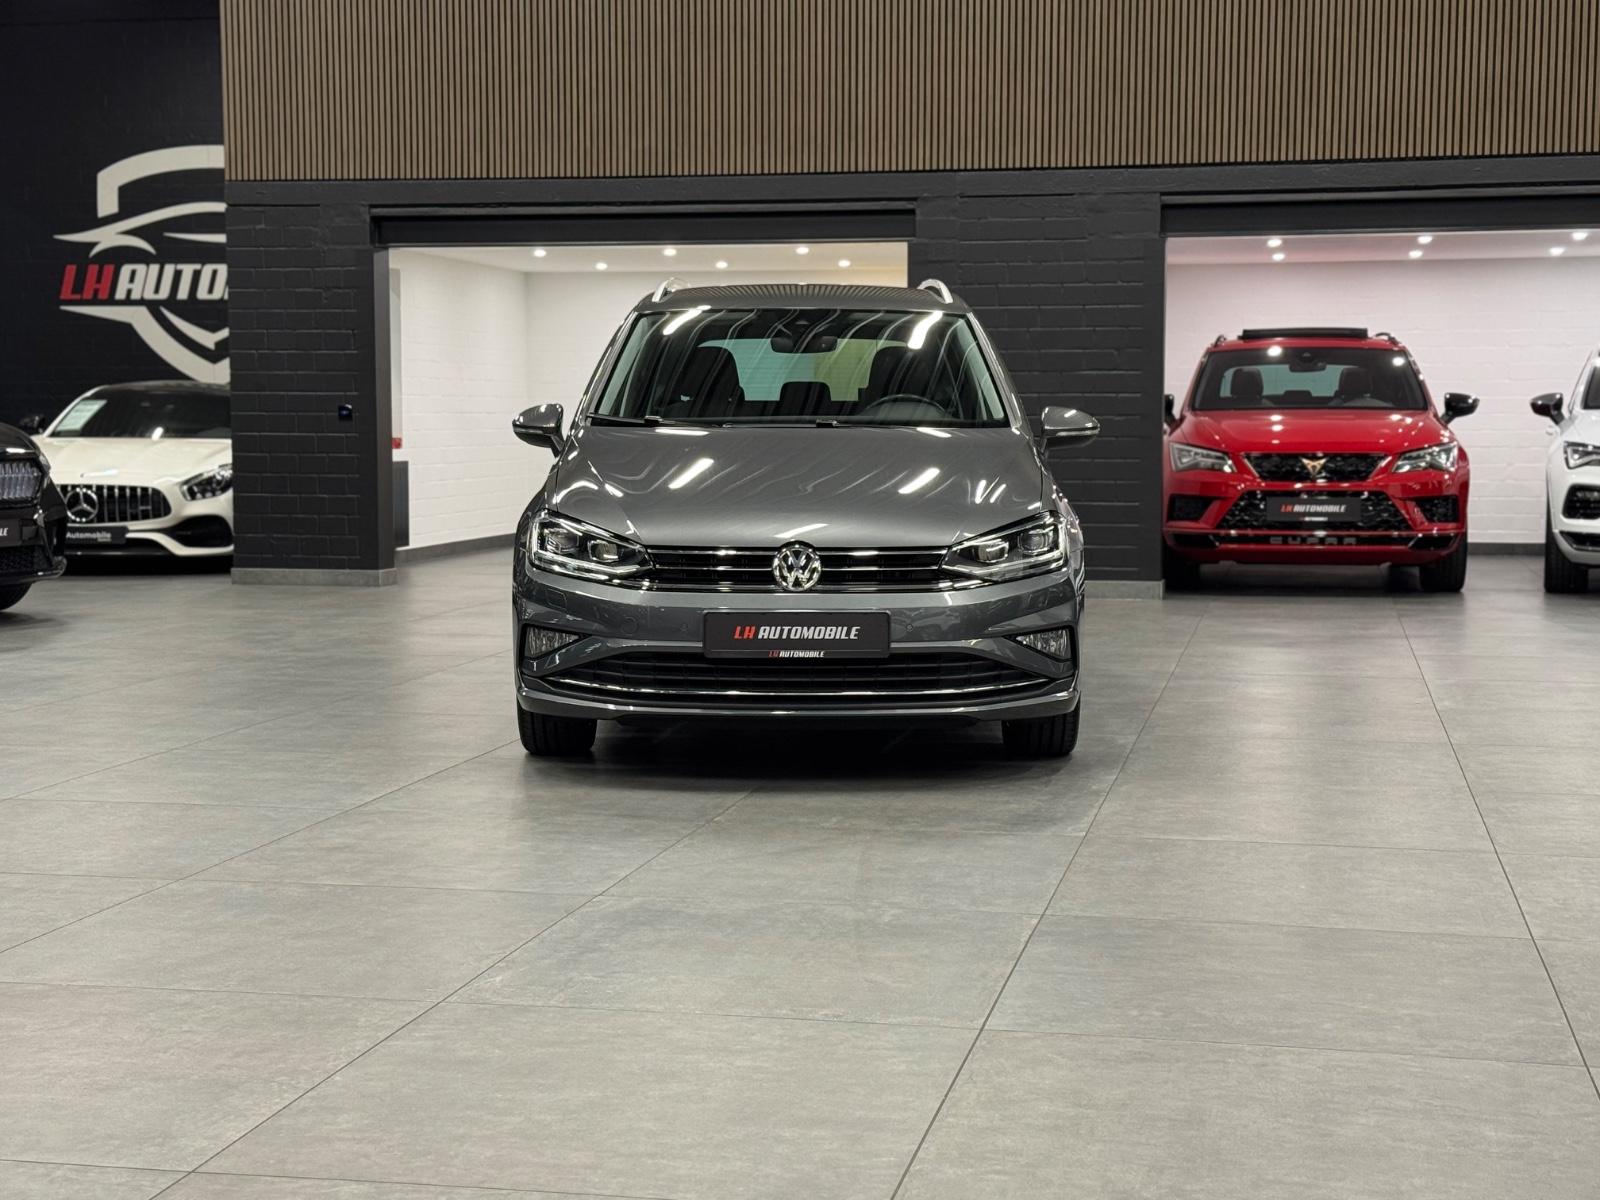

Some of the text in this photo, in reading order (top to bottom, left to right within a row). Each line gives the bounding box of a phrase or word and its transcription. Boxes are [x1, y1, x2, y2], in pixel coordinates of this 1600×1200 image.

[59, 263, 228, 300] LH AUTO
[1293, 504, 1346, 512] AUTOMOBILE
[734, 625, 861, 640] LH AUTOMOBILE
[778, 650, 825, 658] AUTOMOBILE
